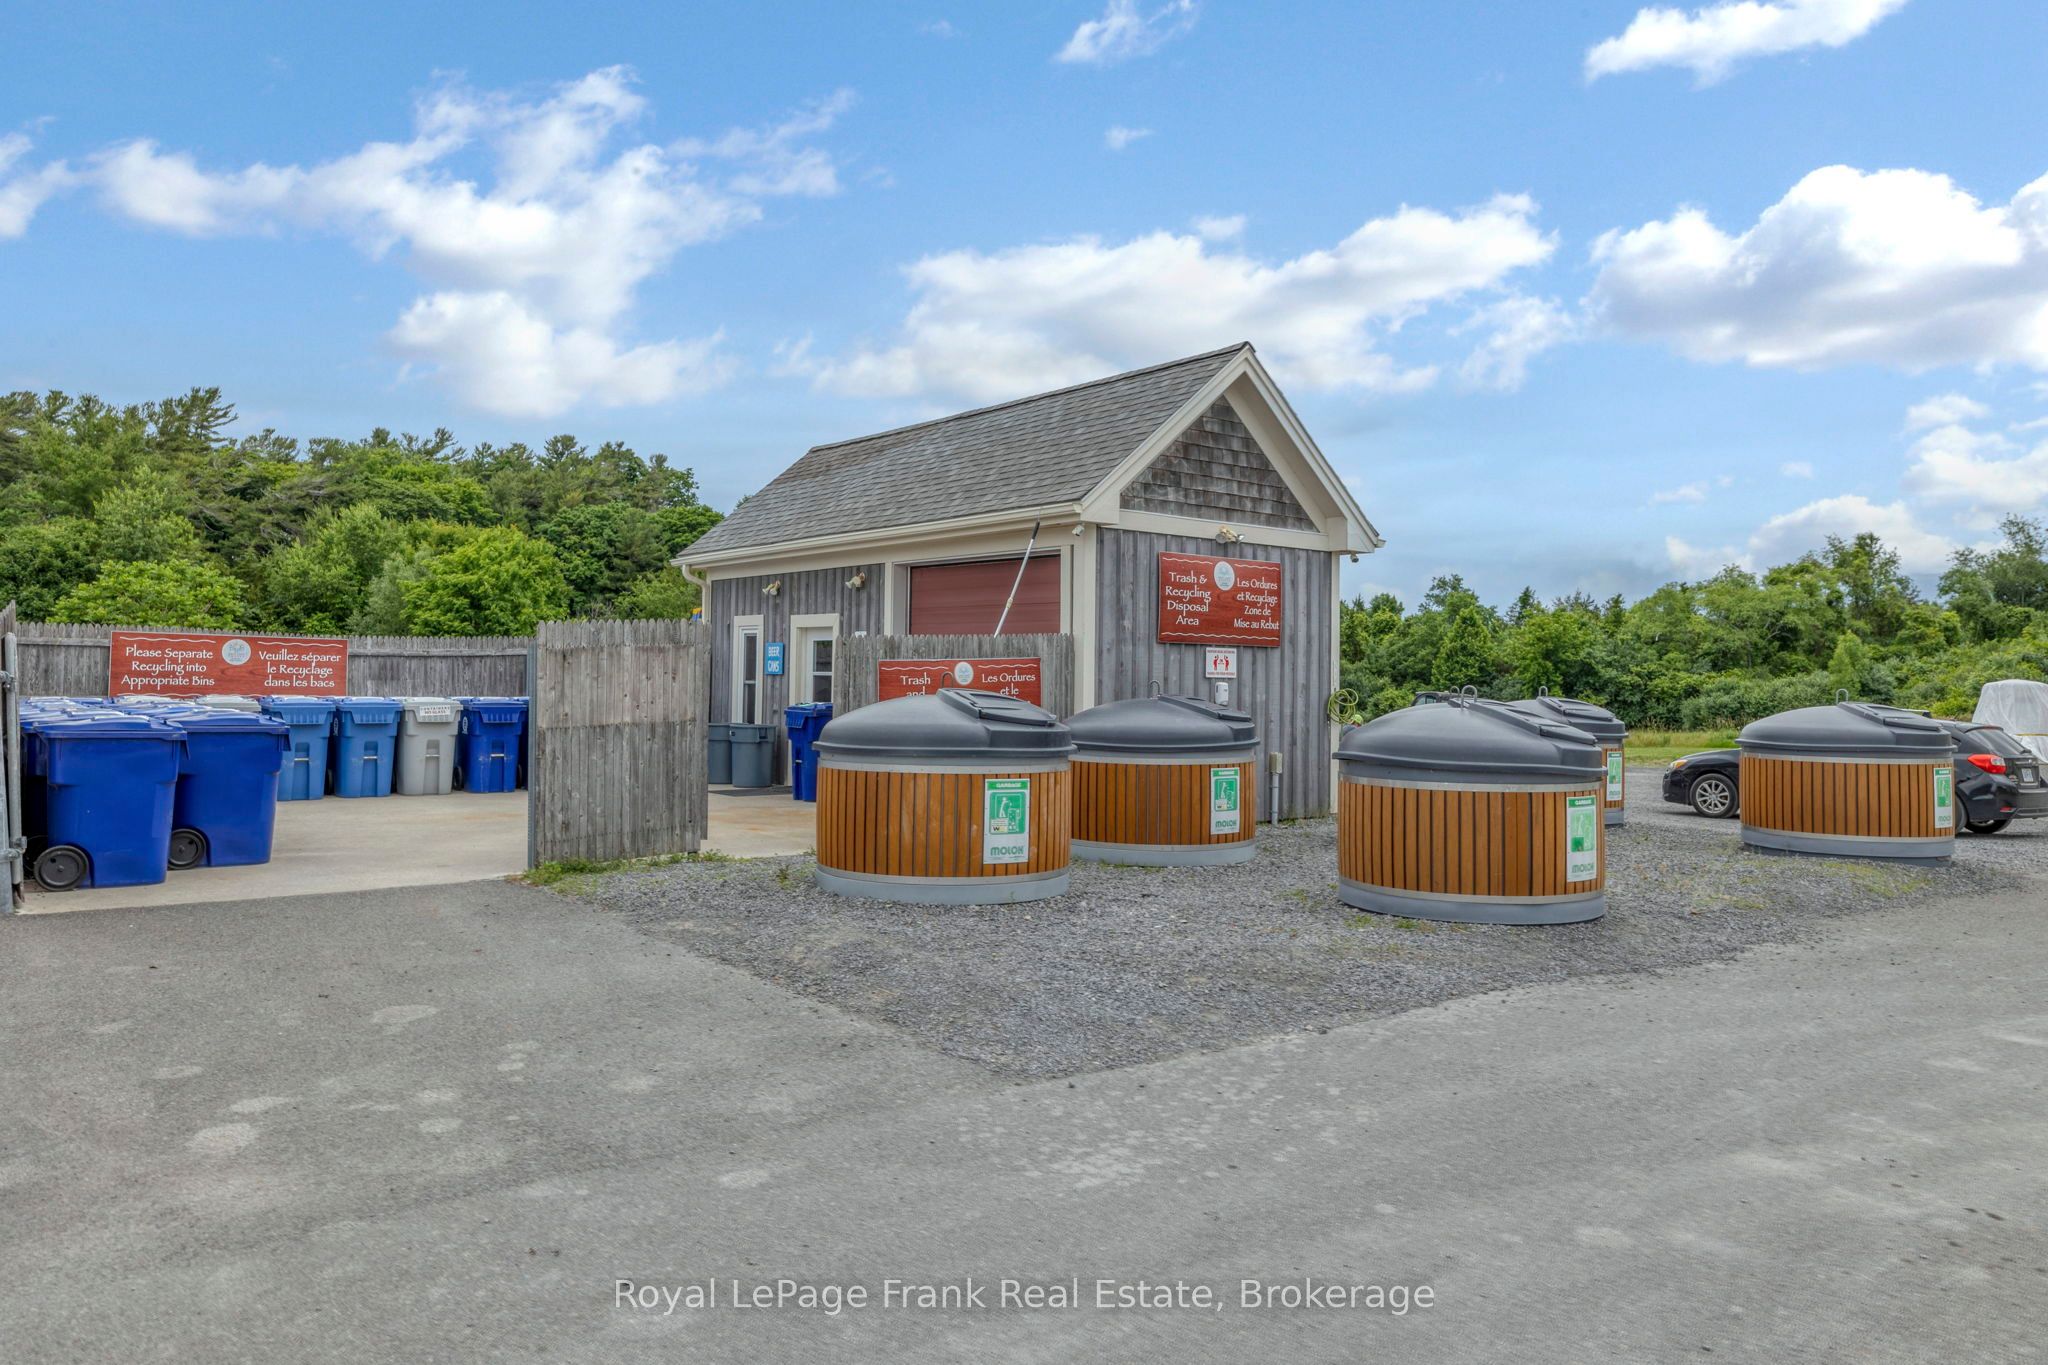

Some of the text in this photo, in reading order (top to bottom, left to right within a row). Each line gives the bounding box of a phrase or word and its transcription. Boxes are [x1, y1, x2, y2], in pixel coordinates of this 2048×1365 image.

[1168, 570, 1197, 583] Trash
[1199, 575, 1208, 584] &
[1236, 577, 1249, 588] Les
[1250, 577, 1278, 590] Ordures
[1165, 585, 1212, 602] Recycling
[1236, 590, 1278, 607] et Recyclage
[1167, 600, 1209, 616] Disposal
[1244, 604, 1271, 616] Zone de
[1175, 615, 1199, 626] Area
[1233, 617, 1280, 630] Mise au Rebut
[126, 644, 162, 657] Please
[164, 648, 213, 663] Separate
[258, 649, 298, 661] Veuillez
[301, 652, 341, 666] séparer
[768, 646, 780, 657] BEER
[131, 659, 207, 675] Recycling into
[267, 661, 333, 678] le Recyclage
[121, 674, 215, 690] Appropriate Bins
[264, 674, 335, 688] dans les bacs
[900, 672, 931, 685] Trash
[981, 673, 998, 683] Les
[999, 670, 1036, 682] Ordures
[1000, 683, 1019, 696] et le
